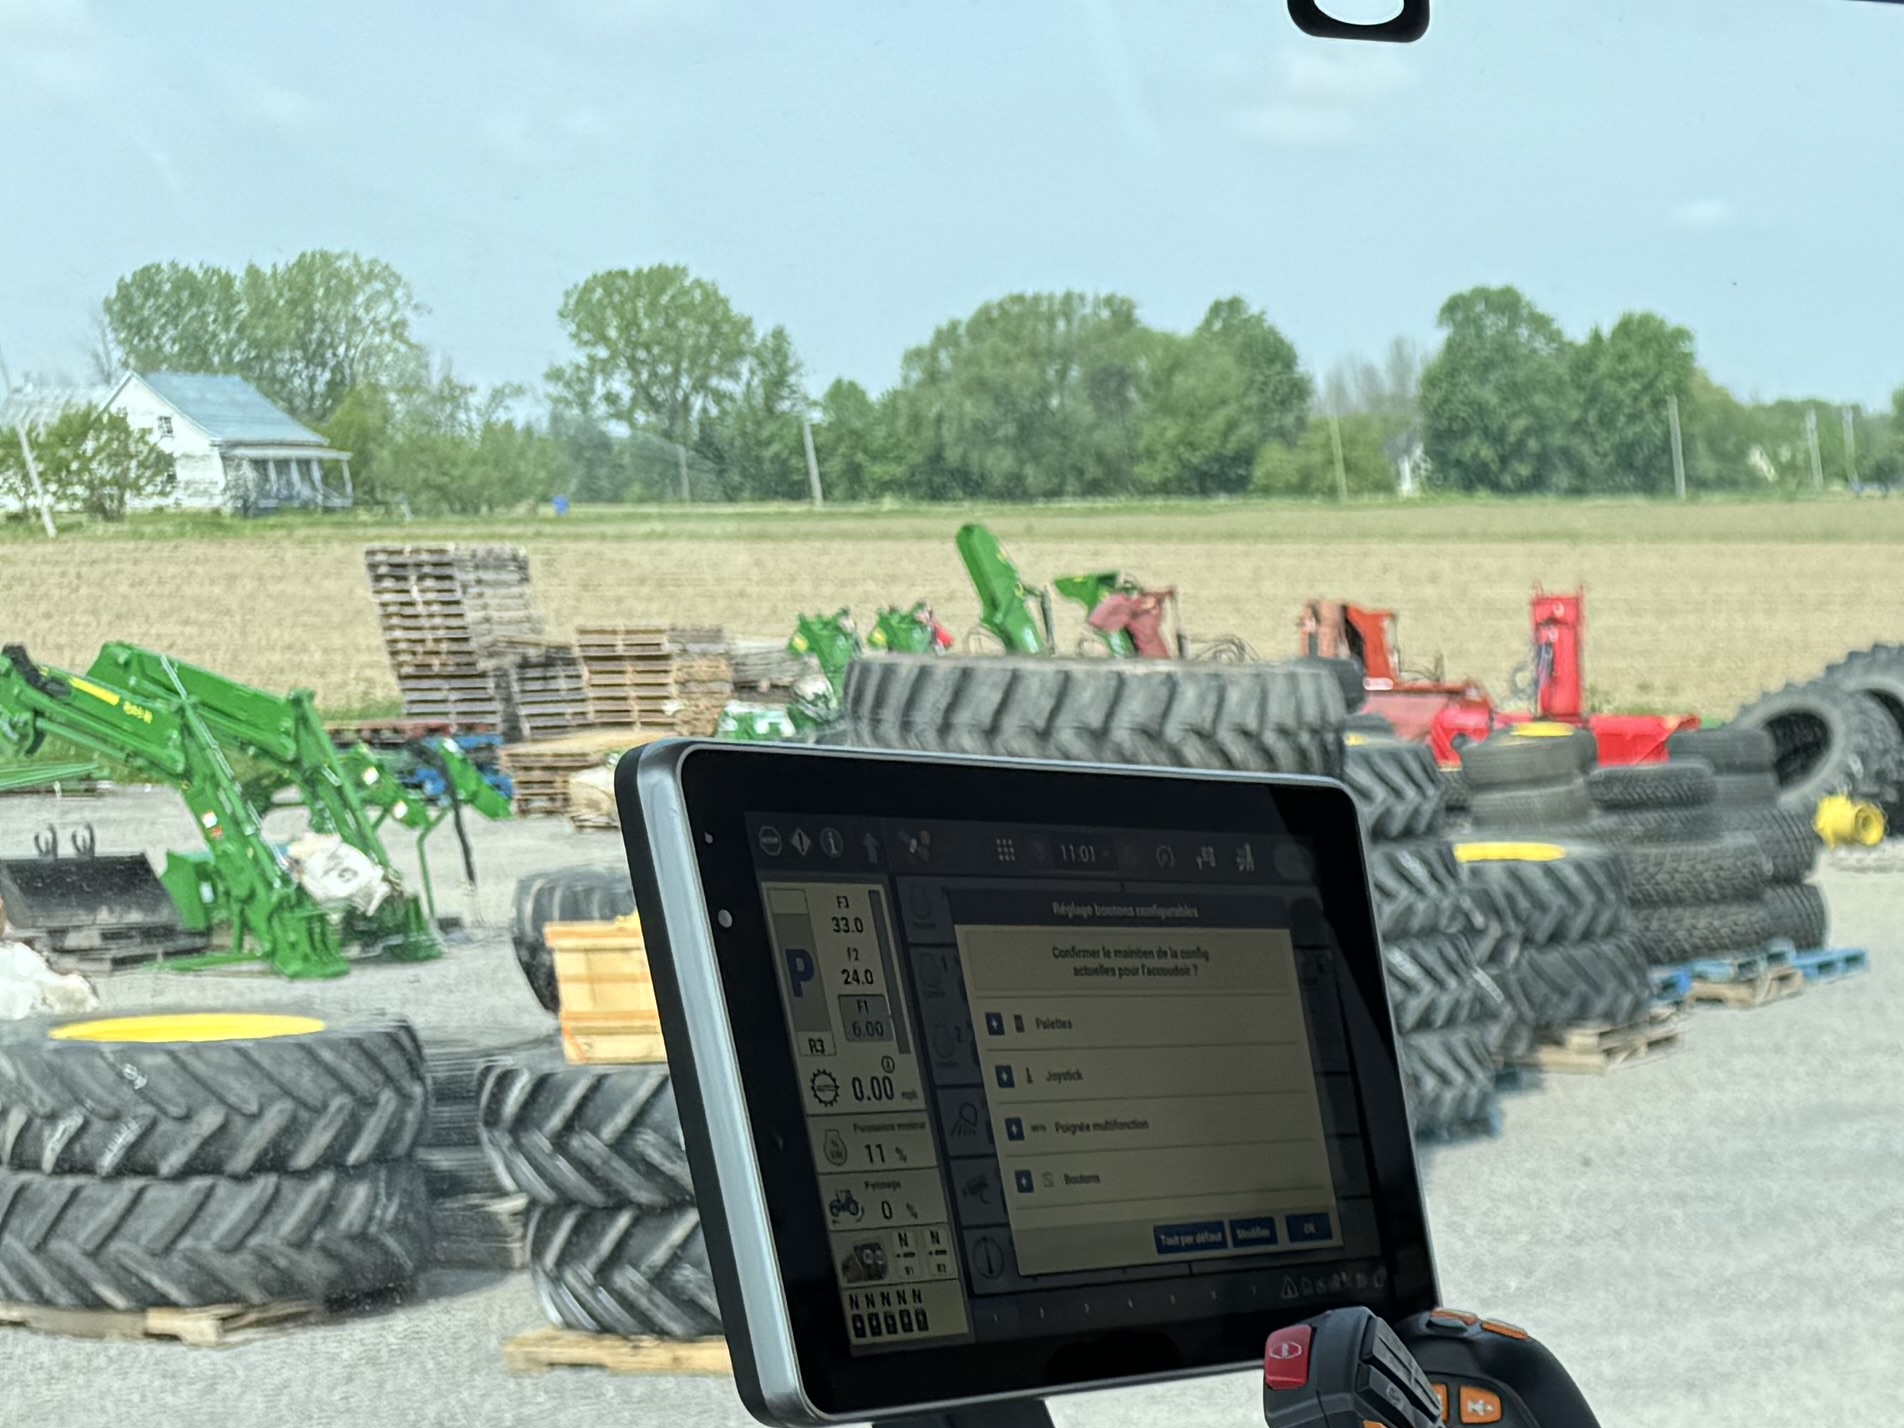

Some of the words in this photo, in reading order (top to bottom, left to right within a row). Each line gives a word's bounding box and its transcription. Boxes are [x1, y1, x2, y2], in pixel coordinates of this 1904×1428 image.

[1061, 844, 1097, 863] 11:01
[836, 895, 850, 909] F3
[831, 917, 864, 934] 33.0
[847, 947, 860, 961] F2
[1052, 946, 1101, 959] Confirmer
[785, 948, 815, 997] P
[840, 969, 874, 985] 24.0
[856, 1000, 869, 1013] F1
[852, 1020, 884, 1037] 6.00
[1035, 1017, 1073, 1030] Palettes
[809, 1038, 826, 1054] R3
[1046, 1069, 1084, 1084] Joystick
[852, 1075, 894, 1102] 0.00
[865, 1144, 885, 1164] 11
[881, 1200, 893, 1220] 0
[898, 1232, 909, 1248] N
[930, 1230, 941, 1245] N
[865, 1293, 876, 1309] N
[881, 1291, 892, 1307] N
[896, 1289, 907, 1305] N
[912, 1288, 923, 1304] N
